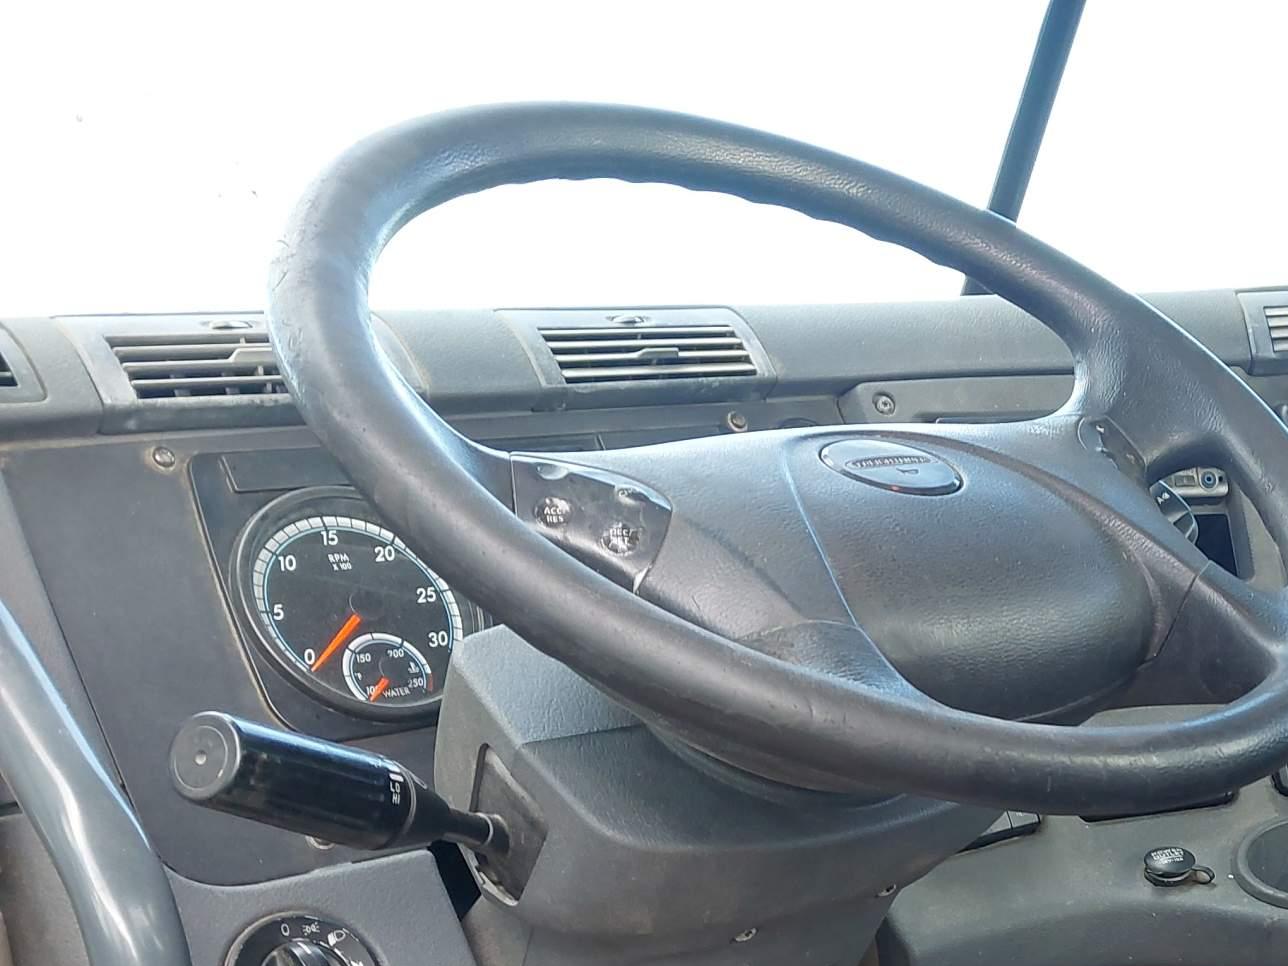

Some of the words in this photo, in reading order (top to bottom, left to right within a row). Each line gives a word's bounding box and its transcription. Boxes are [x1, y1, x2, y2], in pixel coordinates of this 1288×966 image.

[546, 515, 564, 523] RES
[321, 530, 338, 546] 15
[328, 553, 350, 563] RPM
[374, 545, 395, 562] 20
[278, 555, 297, 572] 10
[339, 562, 352, 571] 100
[416, 587, 437, 603] 25
[273, 604, 285, 620] 5
[428, 631, 448, 648] 30
[304, 649, 316, 665] 0
[356, 653, 372, 663] 150
[407, 678, 424, 689] 250
[383, 687, 411, 698] WATER
[390, 781, 401, 793] LO
[392, 792, 401, 805] HI
